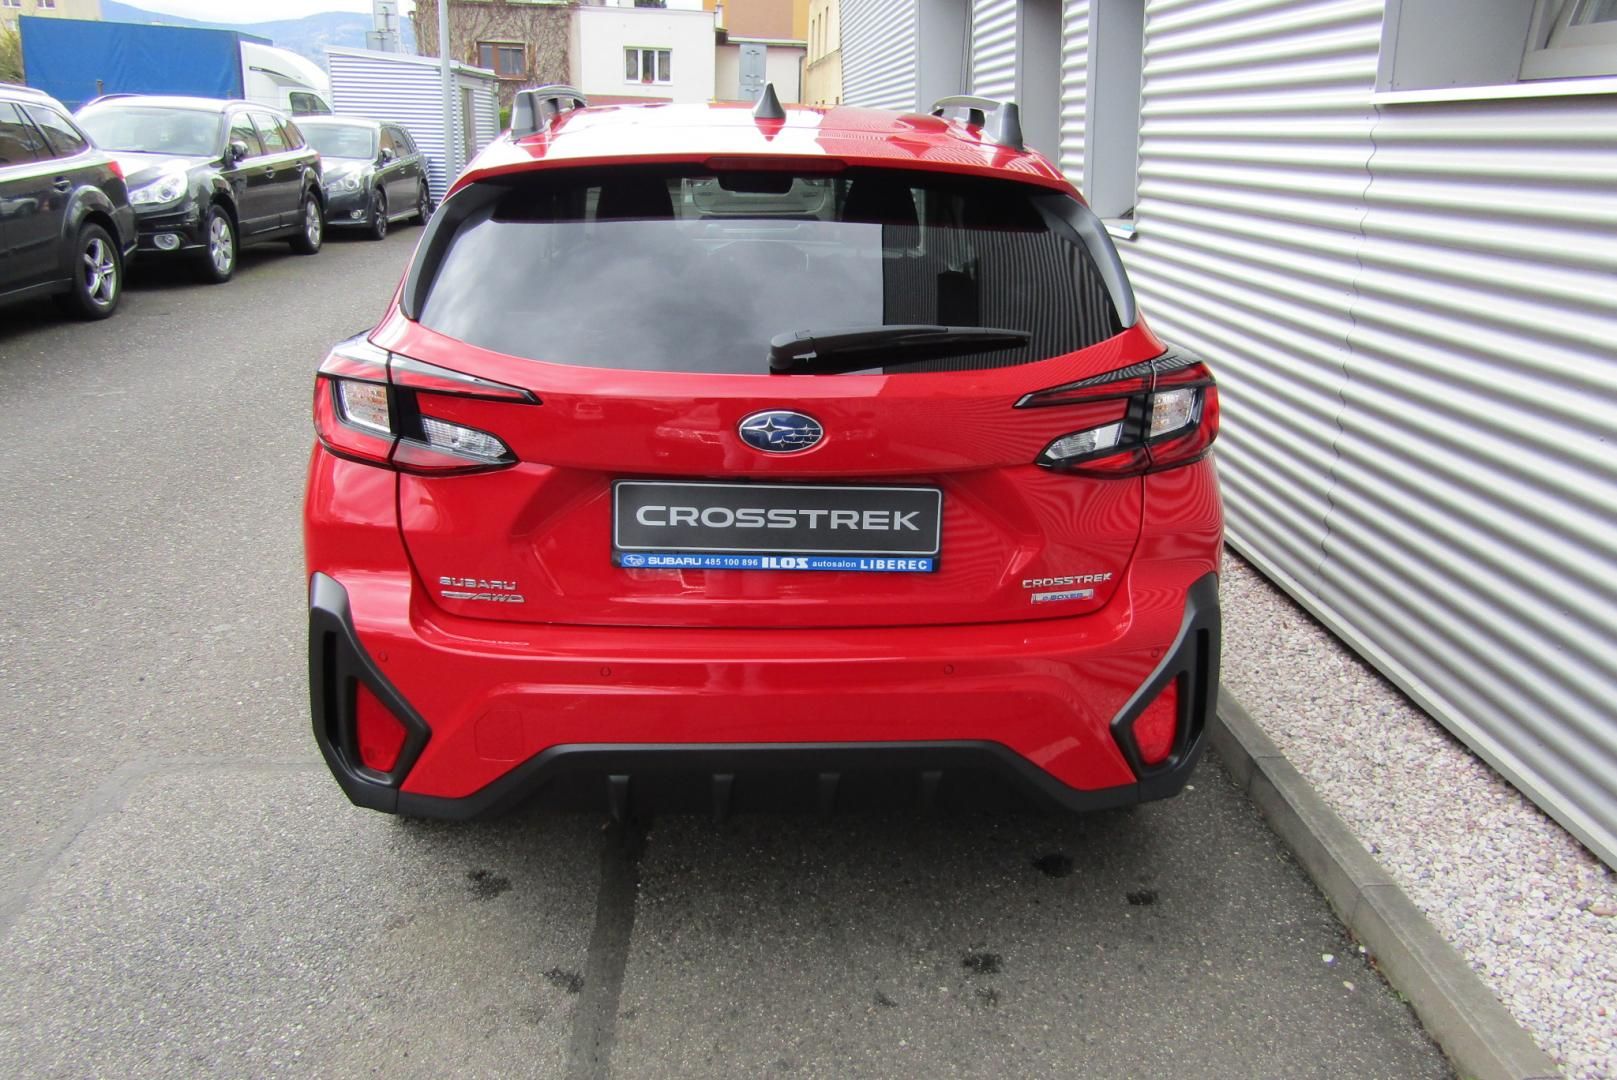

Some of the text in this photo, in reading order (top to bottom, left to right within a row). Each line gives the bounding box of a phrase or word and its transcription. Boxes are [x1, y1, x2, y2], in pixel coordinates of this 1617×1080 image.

[636, 505, 920, 531] CROSSTREK
[648, 556, 928, 570] SUBARU 485 100 896 ILOS autosalon LIBEREC
[439, 576, 516, 590] SUBARU
[1022, 572, 1112, 589] CROSSTREK
[472, 593, 525, 603] AWD
